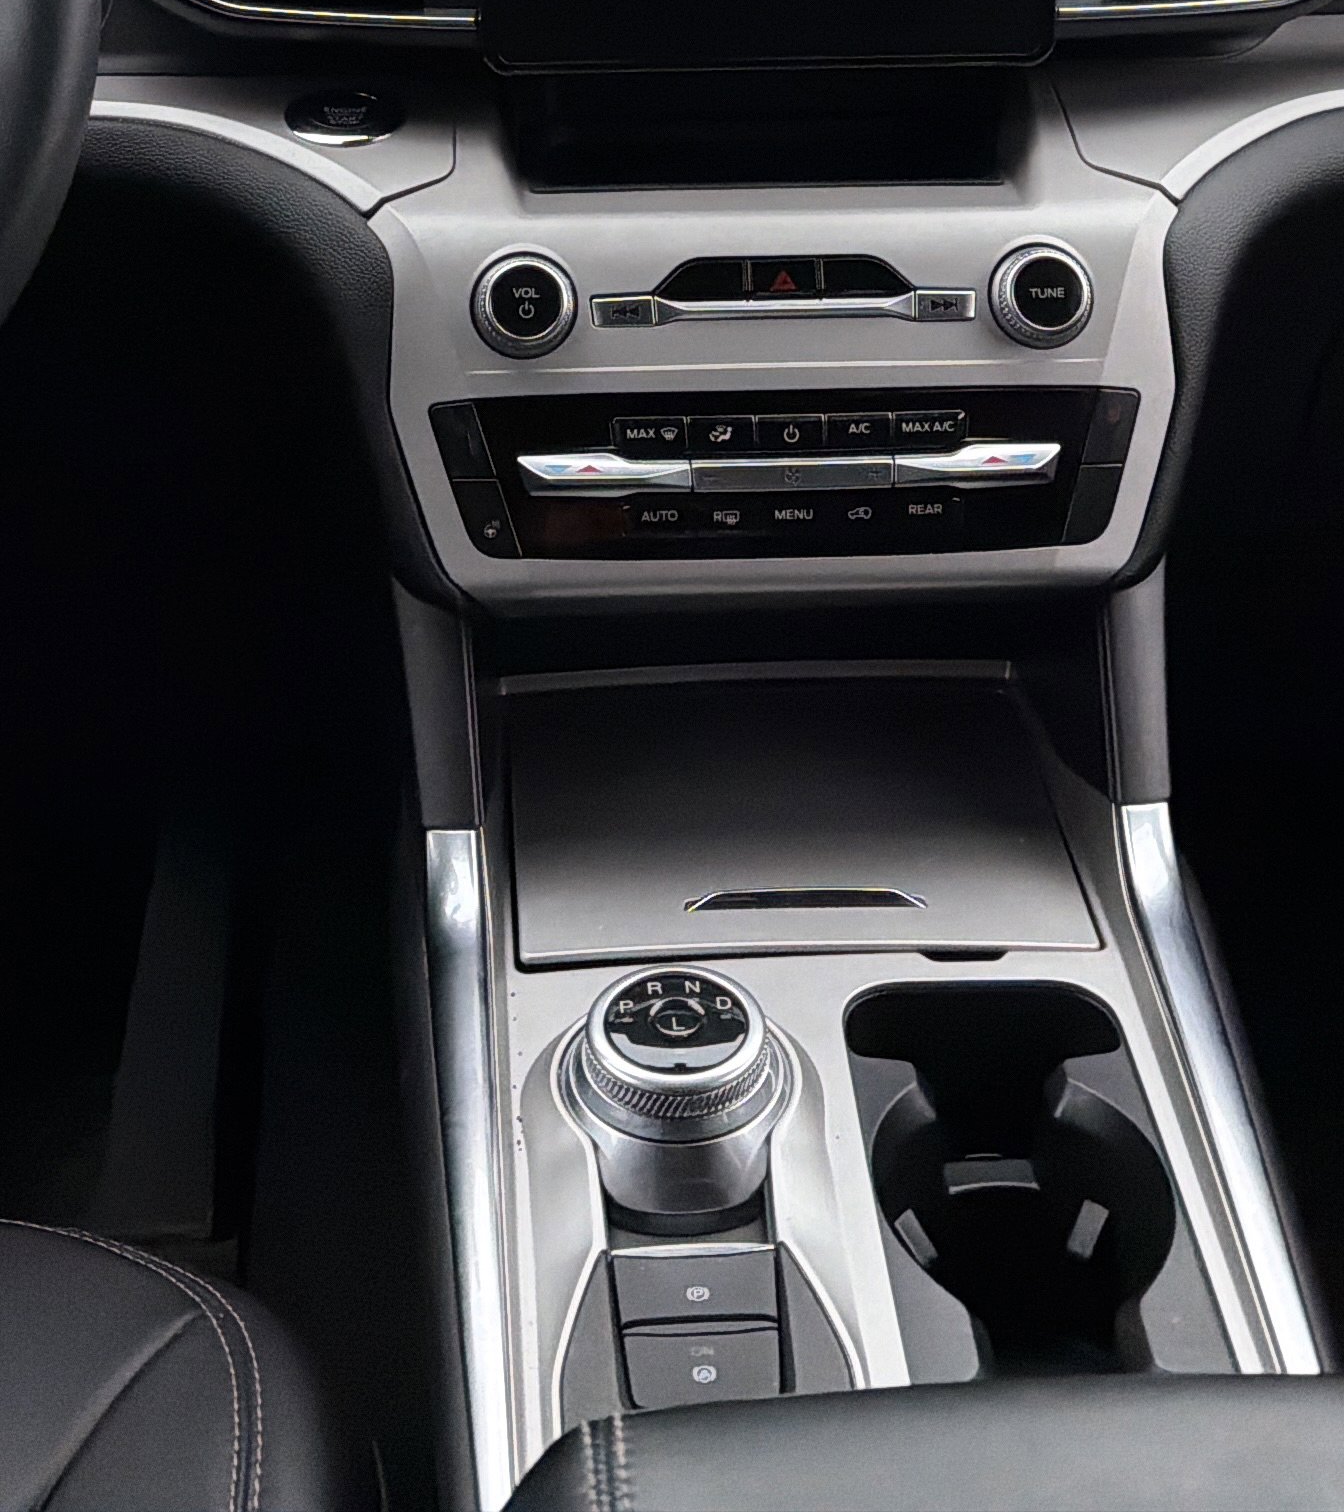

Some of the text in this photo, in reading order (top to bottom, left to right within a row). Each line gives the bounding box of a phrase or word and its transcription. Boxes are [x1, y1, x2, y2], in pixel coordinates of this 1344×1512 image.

[512, 287, 541, 299] VOL
[1028, 286, 1066, 299] TUNE
[848, 423, 872, 434] A/C
[901, 420, 956, 433] MAX A/C
[626, 428, 656, 439] MAX
[640, 509, 679, 522] AUTO
[774, 508, 814, 520] MENU
[908, 503, 943, 515] REAR
[646, 980, 701, 995] R N
[618, 996, 732, 1014] P D
[671, 1016, 686, 1030] L
